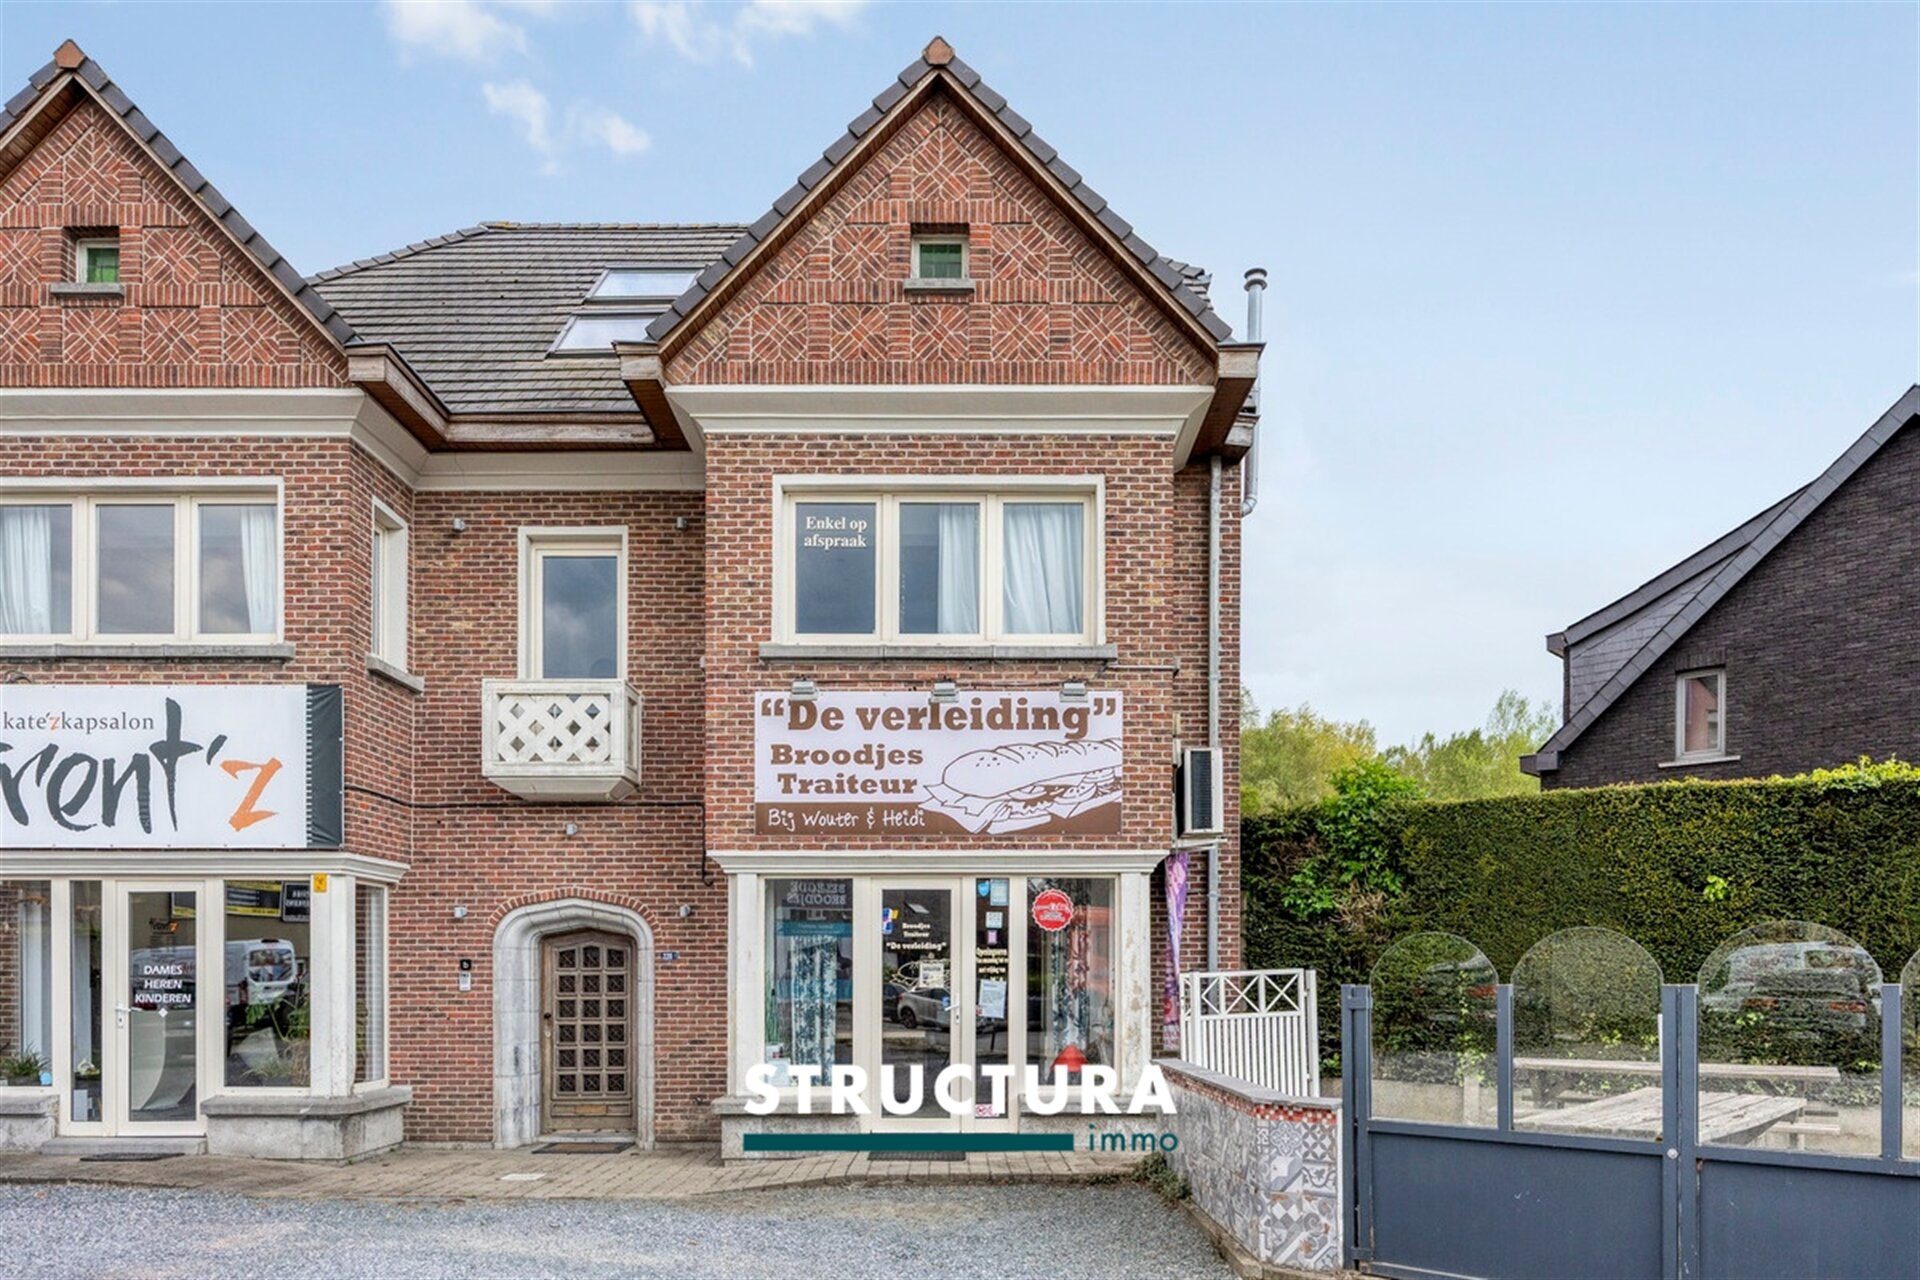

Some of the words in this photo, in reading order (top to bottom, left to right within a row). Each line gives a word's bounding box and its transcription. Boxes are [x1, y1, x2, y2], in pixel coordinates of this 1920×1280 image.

[806, 516, 846, 530] Enkel
[849, 519, 867, 533] op
[804, 534, 867, 550] afspraak
[770, 743, 924, 770] Broodjes
[0, 697, 283, 834] rent'z
[777, 772, 918, 794] Traiteur
[768, 808, 796, 832] Bij
[802, 810, 859, 827] Wouter
[866, 807, 876, 829] &
[883, 809, 925, 827] Heidi
[143, 965, 183, 975] DAMES
[144, 979, 183, 989] HEREN
[135, 993, 192, 1003] KINDEREN
